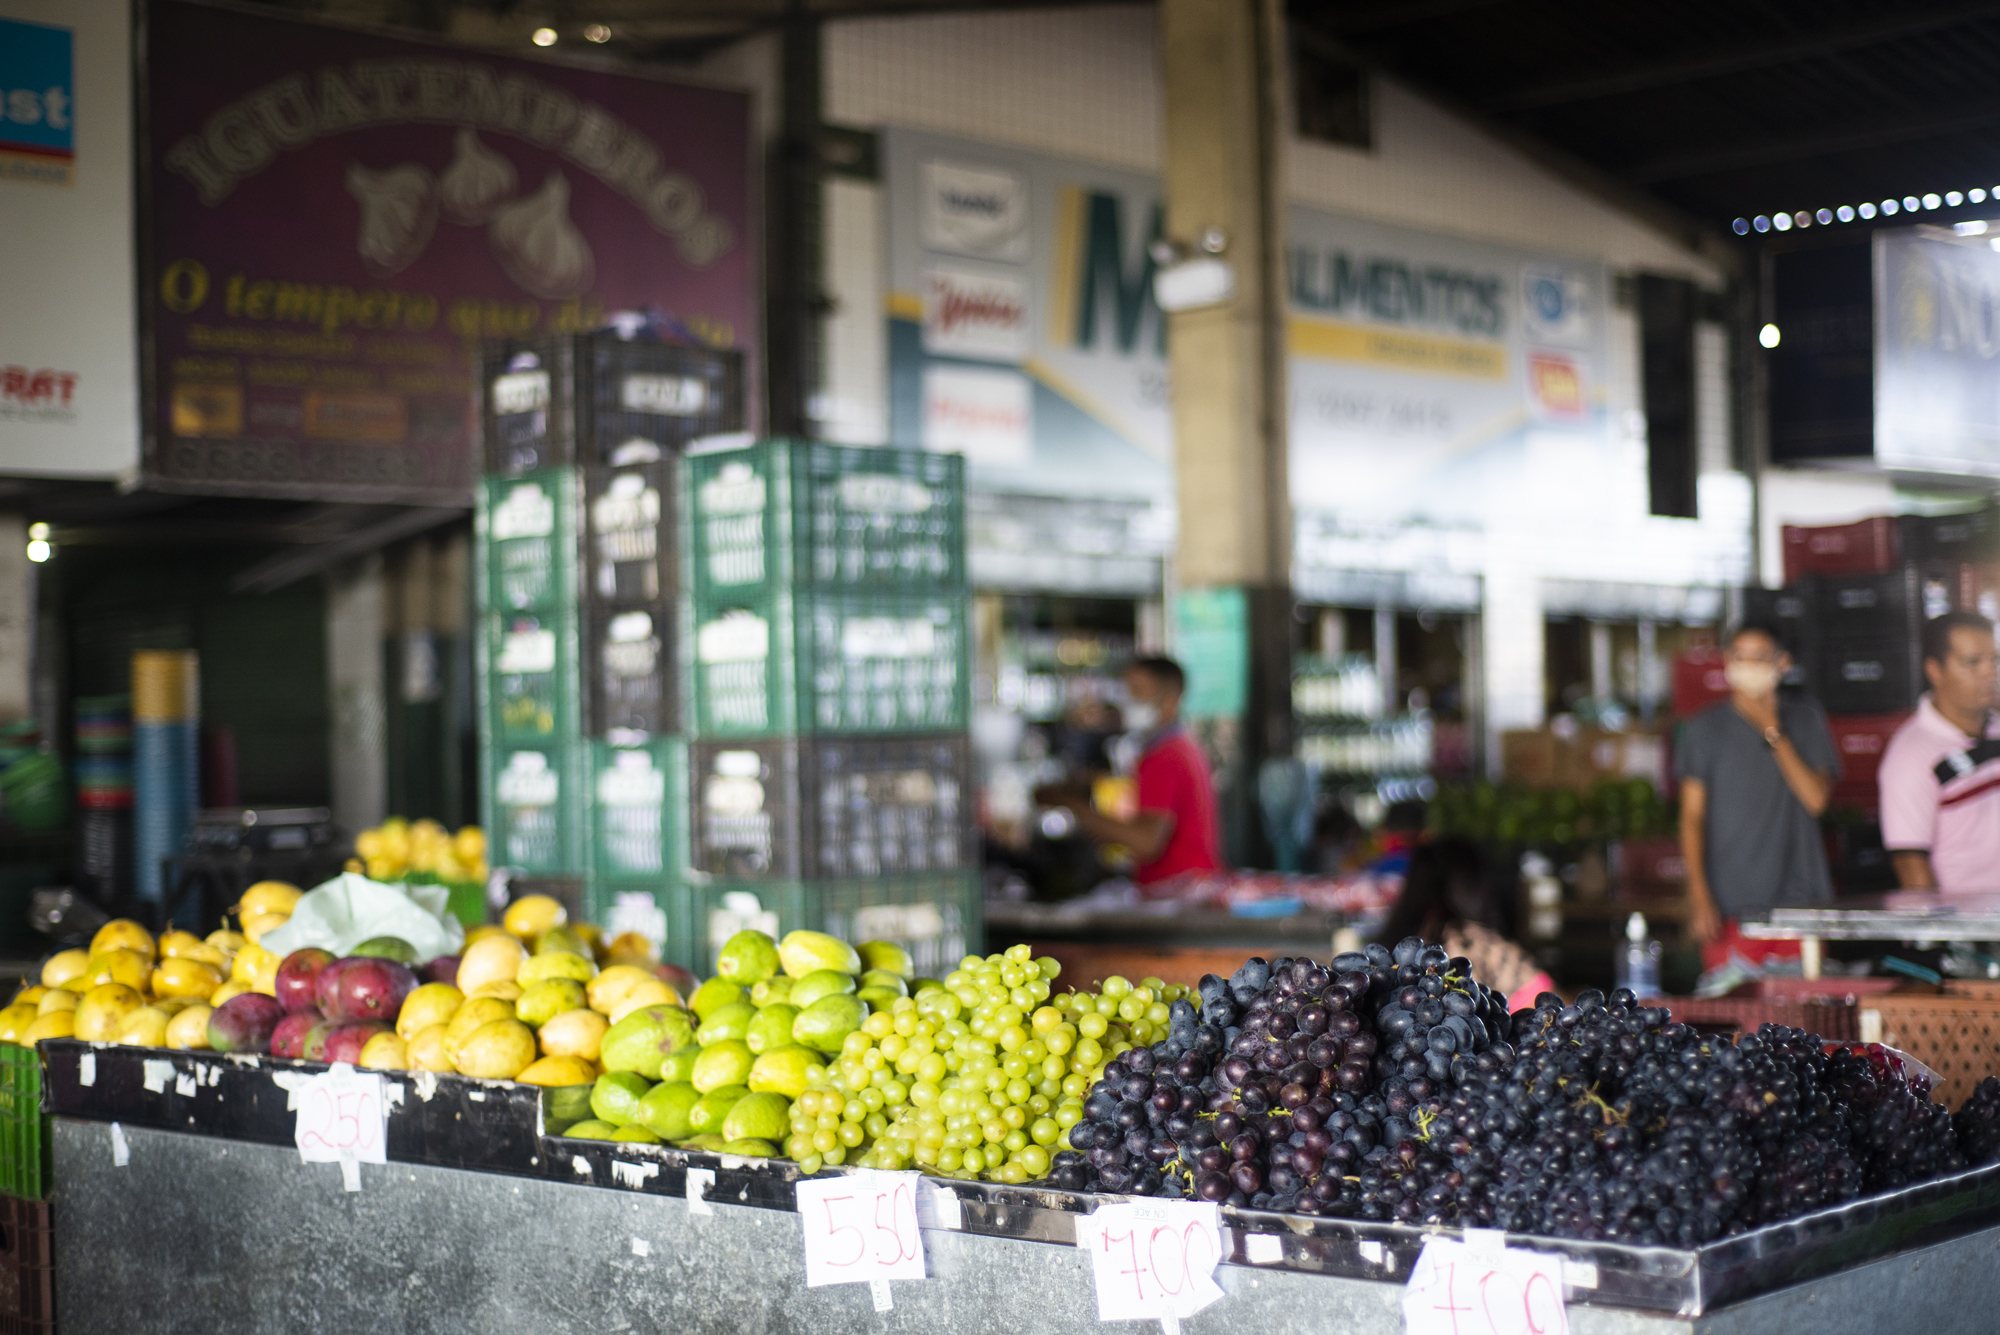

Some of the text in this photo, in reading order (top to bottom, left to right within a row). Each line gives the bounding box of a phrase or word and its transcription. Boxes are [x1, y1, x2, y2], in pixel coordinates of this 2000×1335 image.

[0, 84, 71, 129] st
[164, 57, 736, 268] IGUATEMPEROS
[161, 258, 210, 314] O
[226, 272, 438, 337] tempero
[302, 1087, 378, 1150] 250
